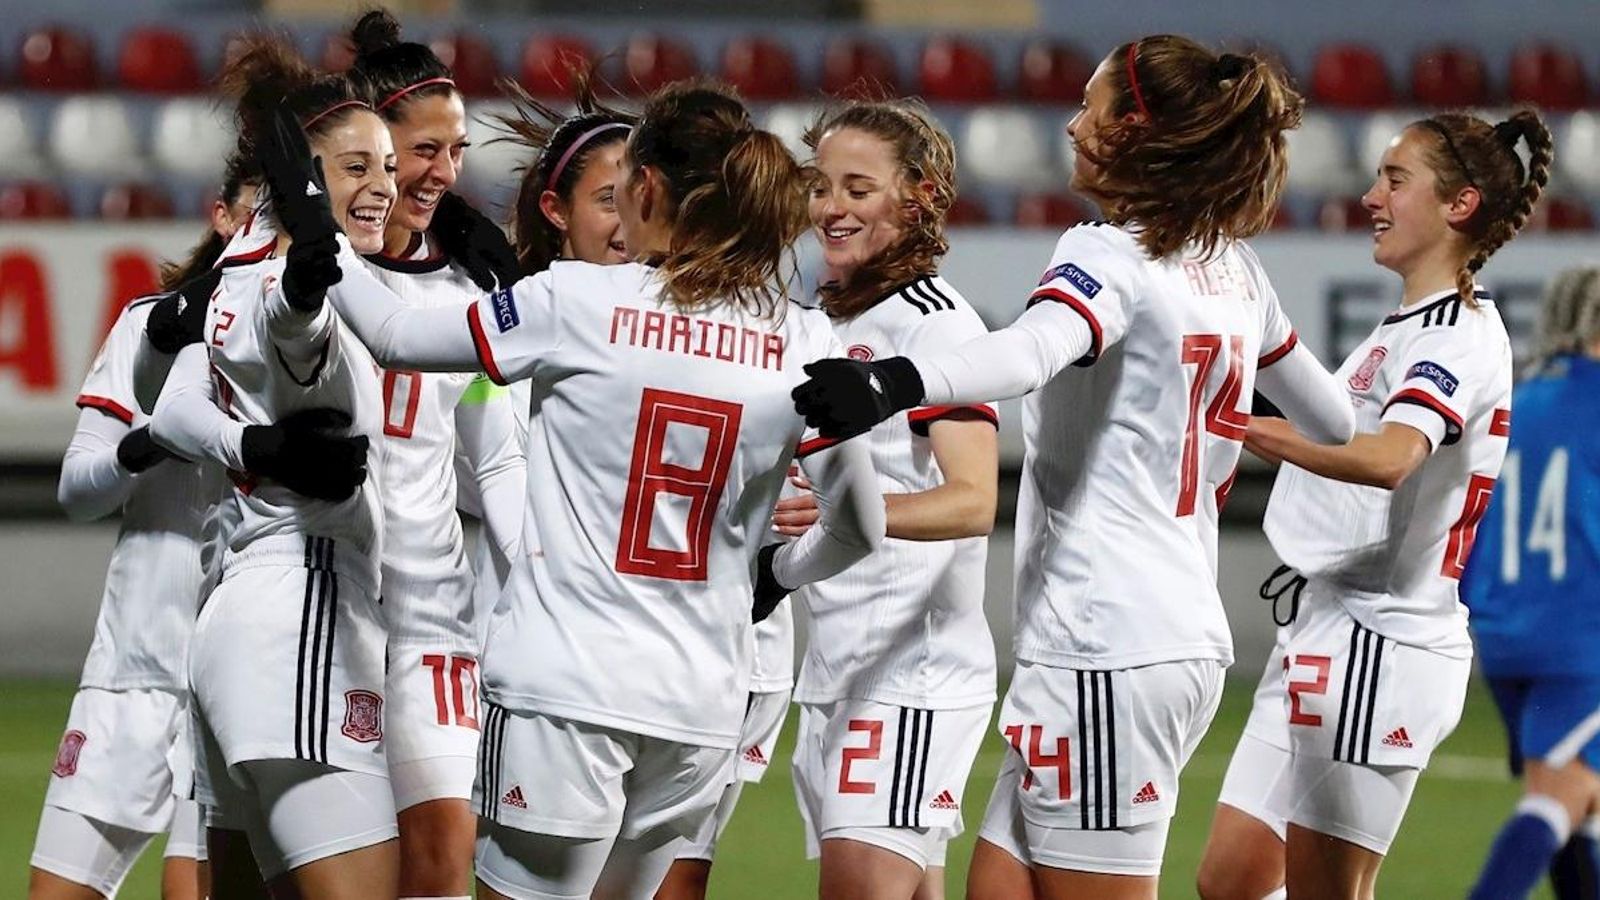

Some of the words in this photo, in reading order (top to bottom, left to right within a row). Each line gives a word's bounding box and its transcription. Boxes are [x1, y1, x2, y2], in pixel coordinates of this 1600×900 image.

[496, 288, 514, 328] SPECT
[609, 306, 784, 372] MARIONA
[615, 387, 744, 582] 8
[1499, 446, 1570, 584] 14
[422, 654, 481, 732] 10
[838, 720, 884, 794] 2
[1004, 724, 1072, 800] 14
[929, 802, 959, 810] adidas
